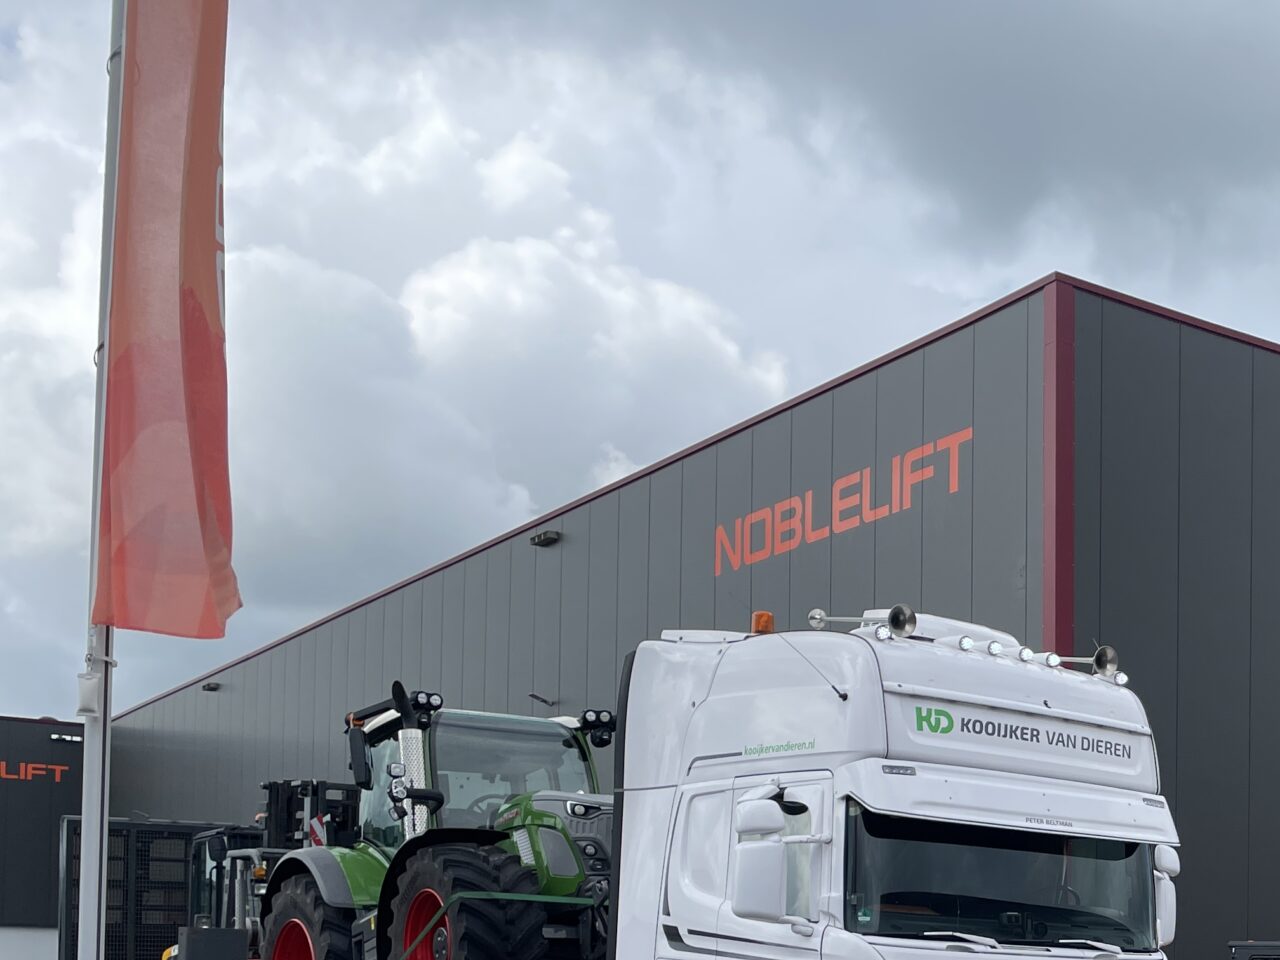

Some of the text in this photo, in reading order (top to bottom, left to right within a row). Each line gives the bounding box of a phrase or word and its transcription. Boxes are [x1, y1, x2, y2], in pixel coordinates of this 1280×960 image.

[714, 426, 973, 577] NOBLELIFT
[744, 738, 816, 757] kooijkervandieren.nl
[960, 717, 1041, 743] KOOIJKER
[1046, 730, 1077, 750] VAN
[1080, 736, 1132, 759] DIEREN
[0, 761, 69, 783] LIFT
[1025, 817, 1073, 828] PETER BELTMAN
